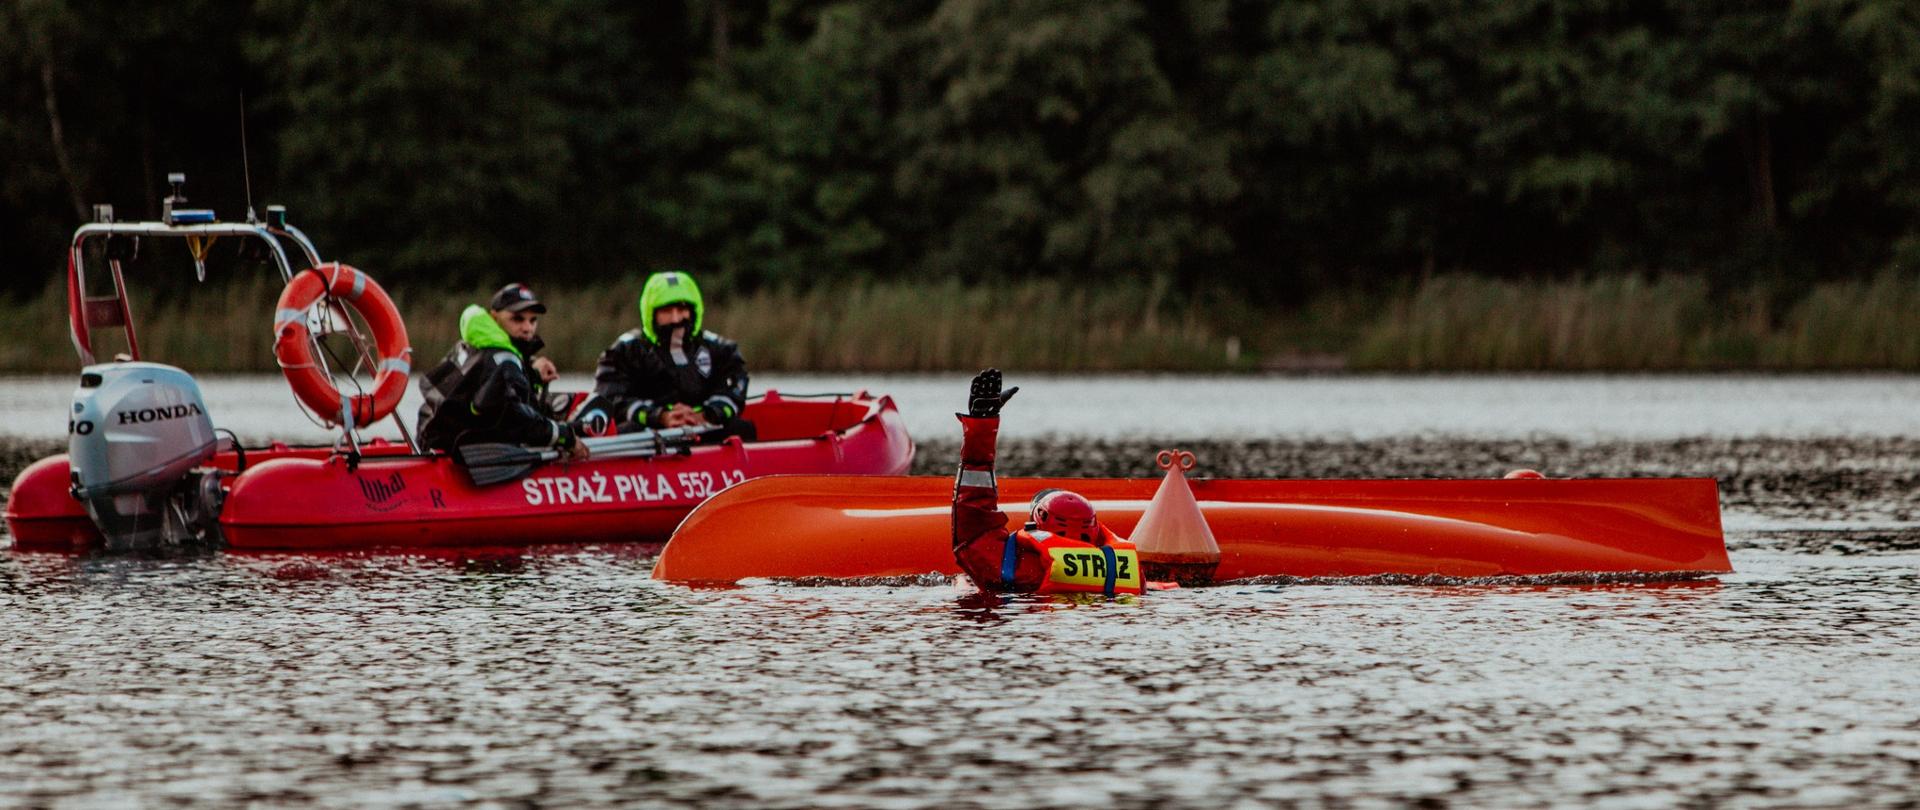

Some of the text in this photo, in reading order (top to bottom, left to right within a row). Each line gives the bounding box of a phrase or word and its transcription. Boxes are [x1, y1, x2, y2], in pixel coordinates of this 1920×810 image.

[118, 403, 201, 425] HONDA
[522, 470, 613, 505] STRAŻ
[614, 473, 677, 502] PIŁA
[677, 471, 718, 498] 552
